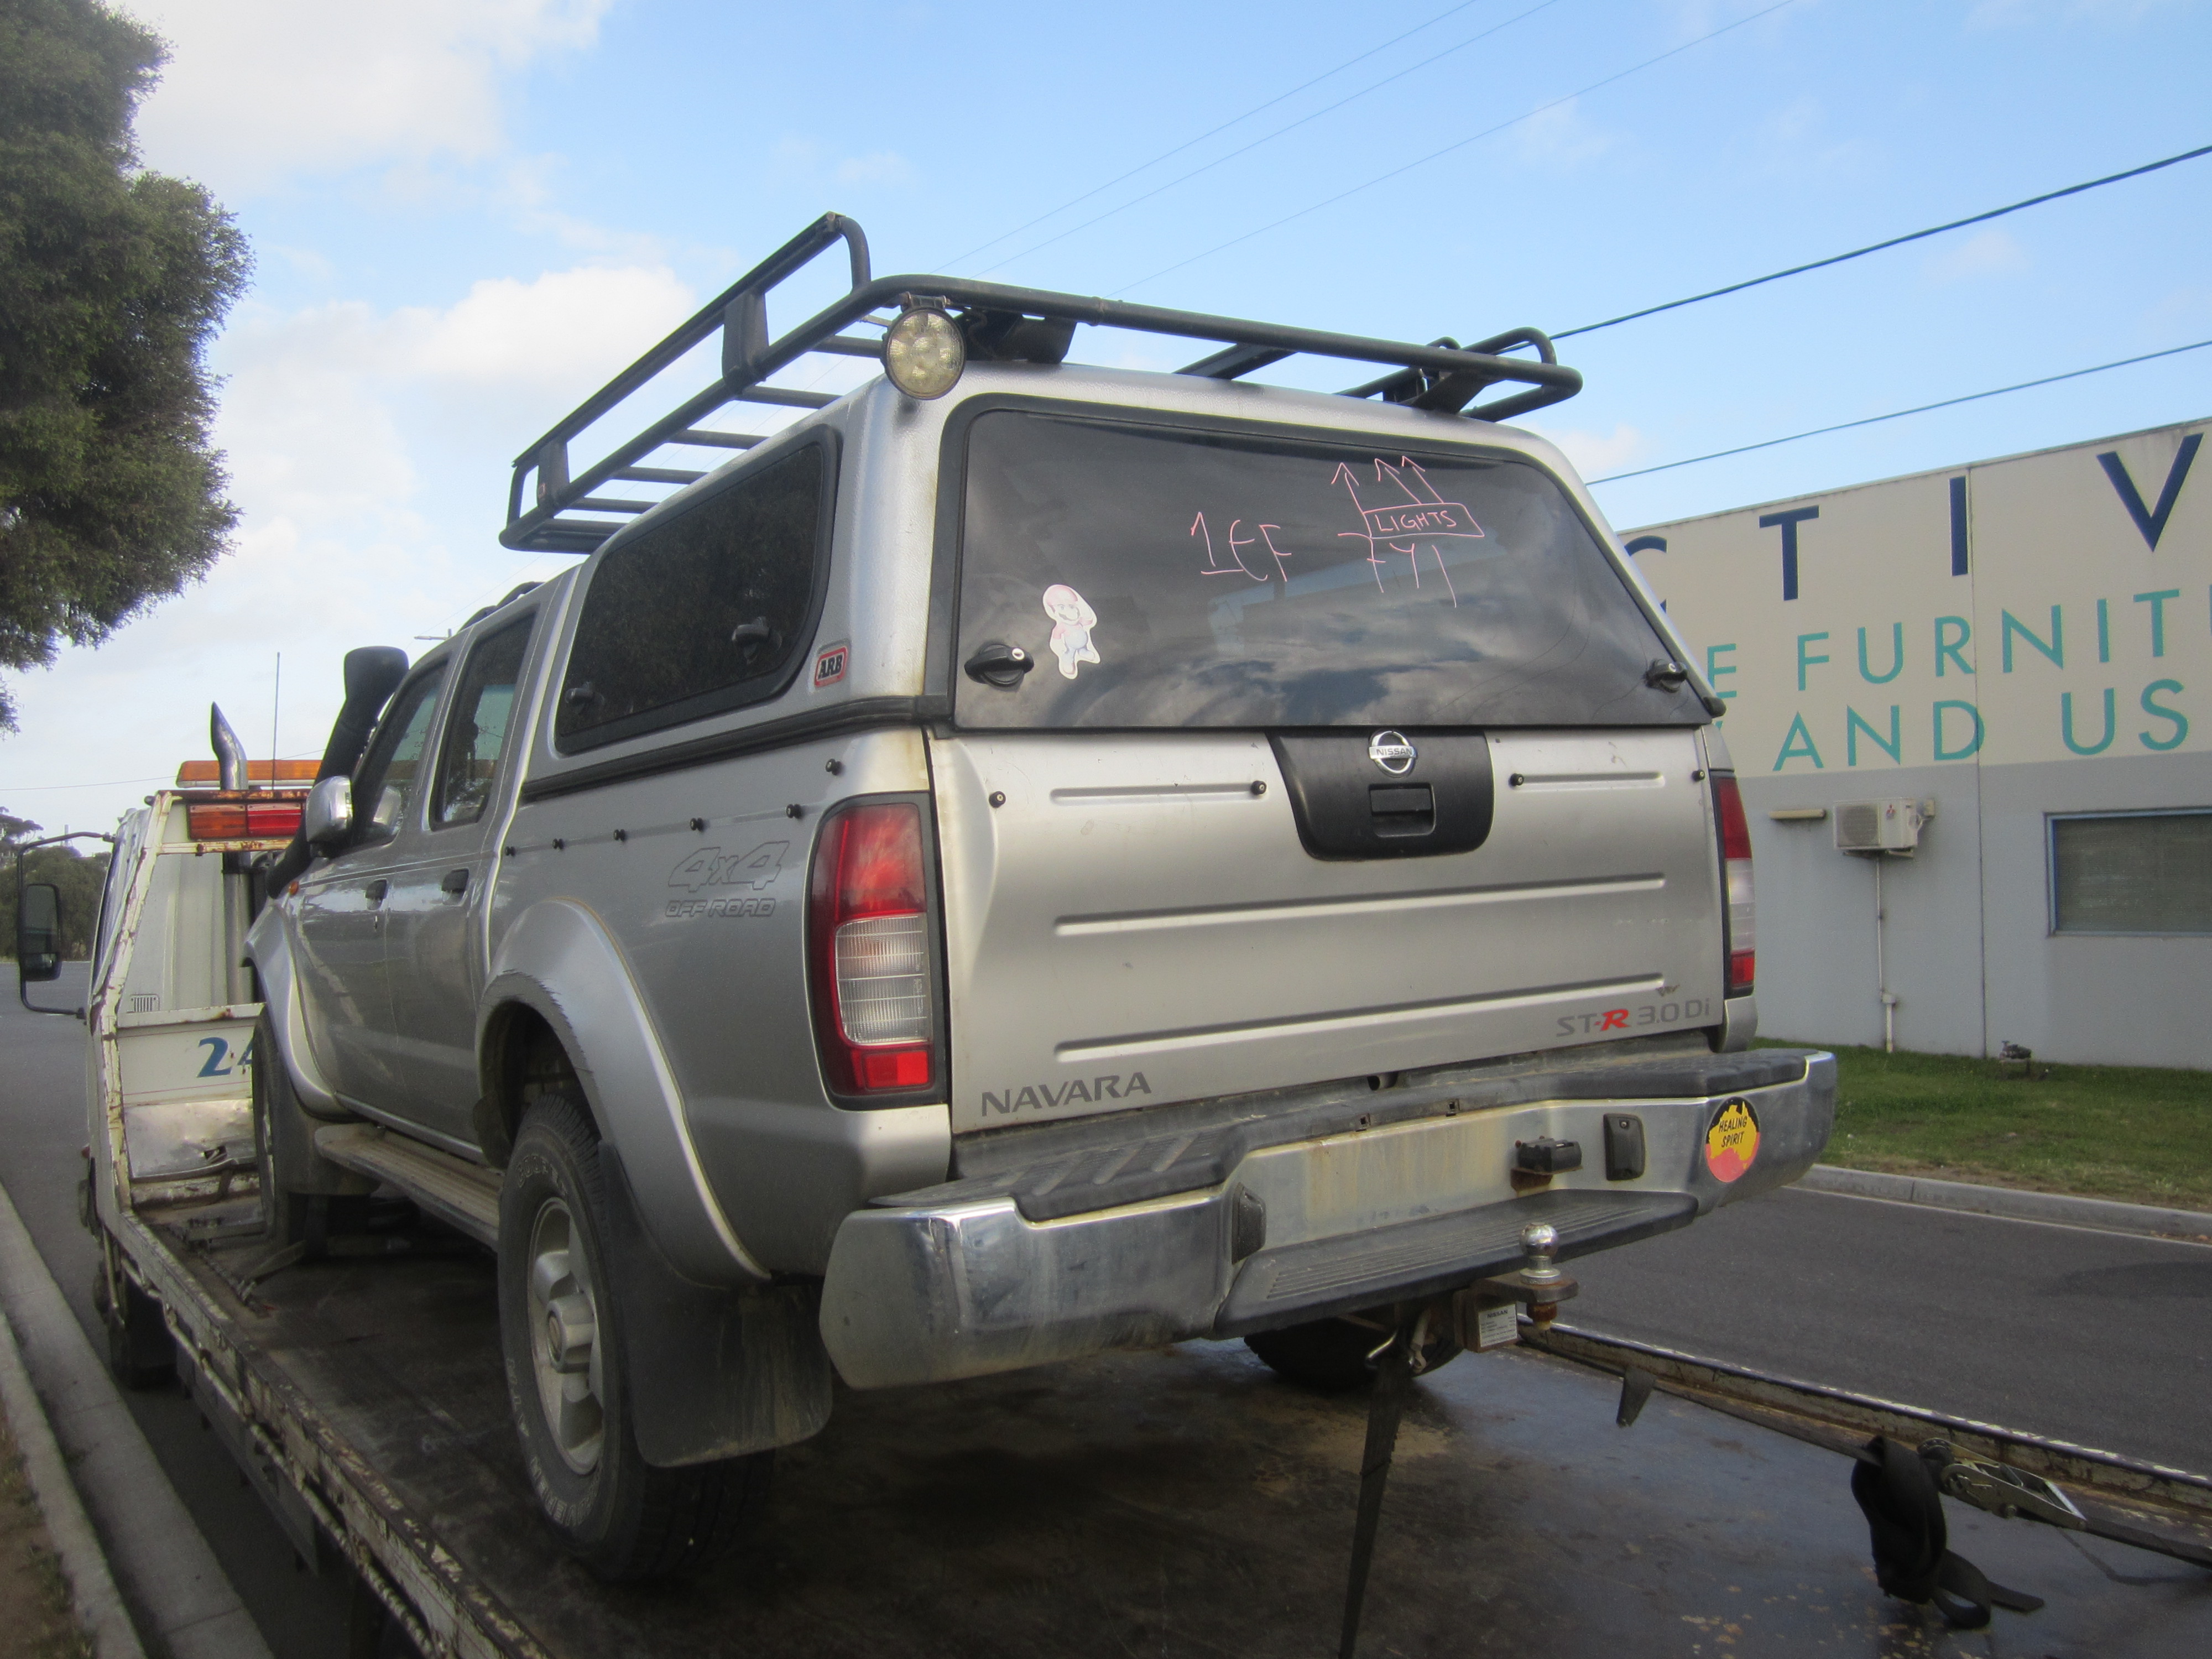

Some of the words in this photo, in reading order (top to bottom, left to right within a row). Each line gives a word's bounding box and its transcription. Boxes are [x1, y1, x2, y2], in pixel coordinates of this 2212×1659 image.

[1374, 510, 1457, 531] LIGHTS
[1797, 584, 2212, 691] FURNIT
[818, 655, 843, 679] ARB
[1773, 700, 1985, 771] AND
[2061, 679, 2189, 756] US
[1376, 748, 1412, 756] NISSAN
[667, 840, 790, 892] 4x4
[665, 899, 708, 917] OFF
[708, 898, 776, 917] ROAD
[982, 1071, 1152, 1117] NAVARA
[1718, 1116, 1747, 1133] HEALING
[1721, 1131, 1744, 1147] SPIRIT
